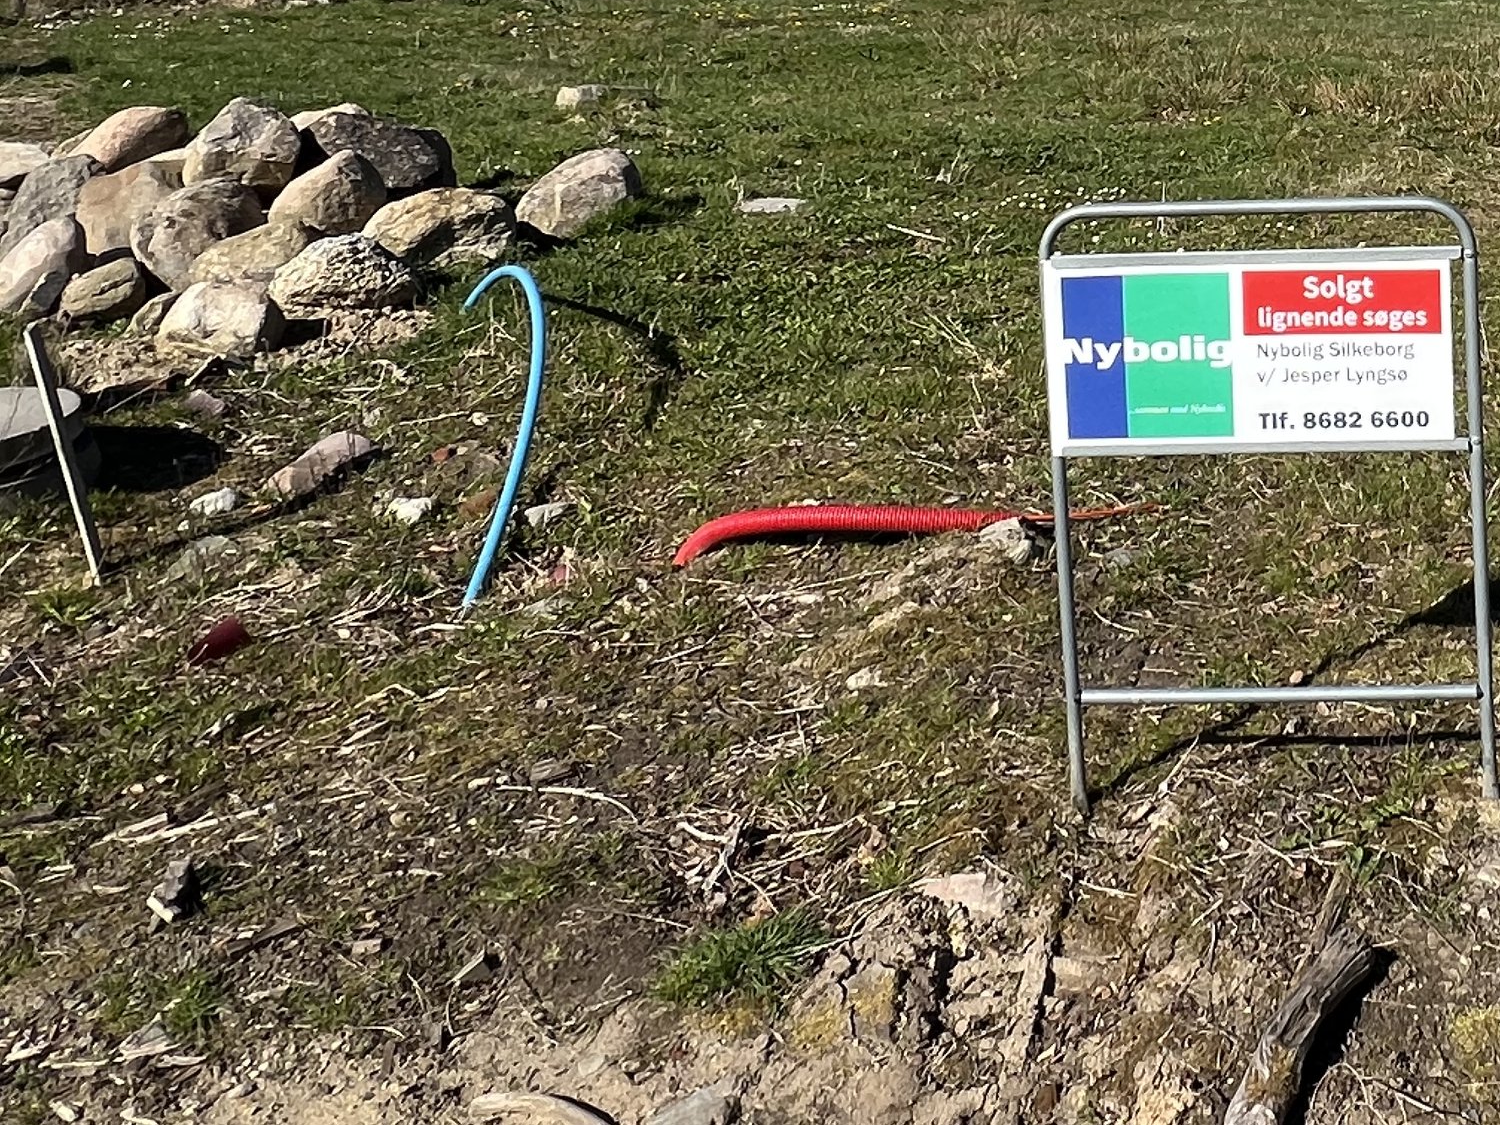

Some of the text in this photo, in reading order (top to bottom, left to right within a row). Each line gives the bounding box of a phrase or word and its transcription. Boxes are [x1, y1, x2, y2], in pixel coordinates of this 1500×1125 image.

[1303, 274, 1374, 304] Solgt
[1257, 306, 1427, 332] lignende søges
[1062, 335, 1232, 370] Nybolig
[1257, 342, 1415, 361] Nybolig Silkeborg
[1257, 368, 1276, 387] v/
[1281, 369, 1340, 385] Jesper
[1258, 410, 1430, 430] Tlf. 8682 6600
